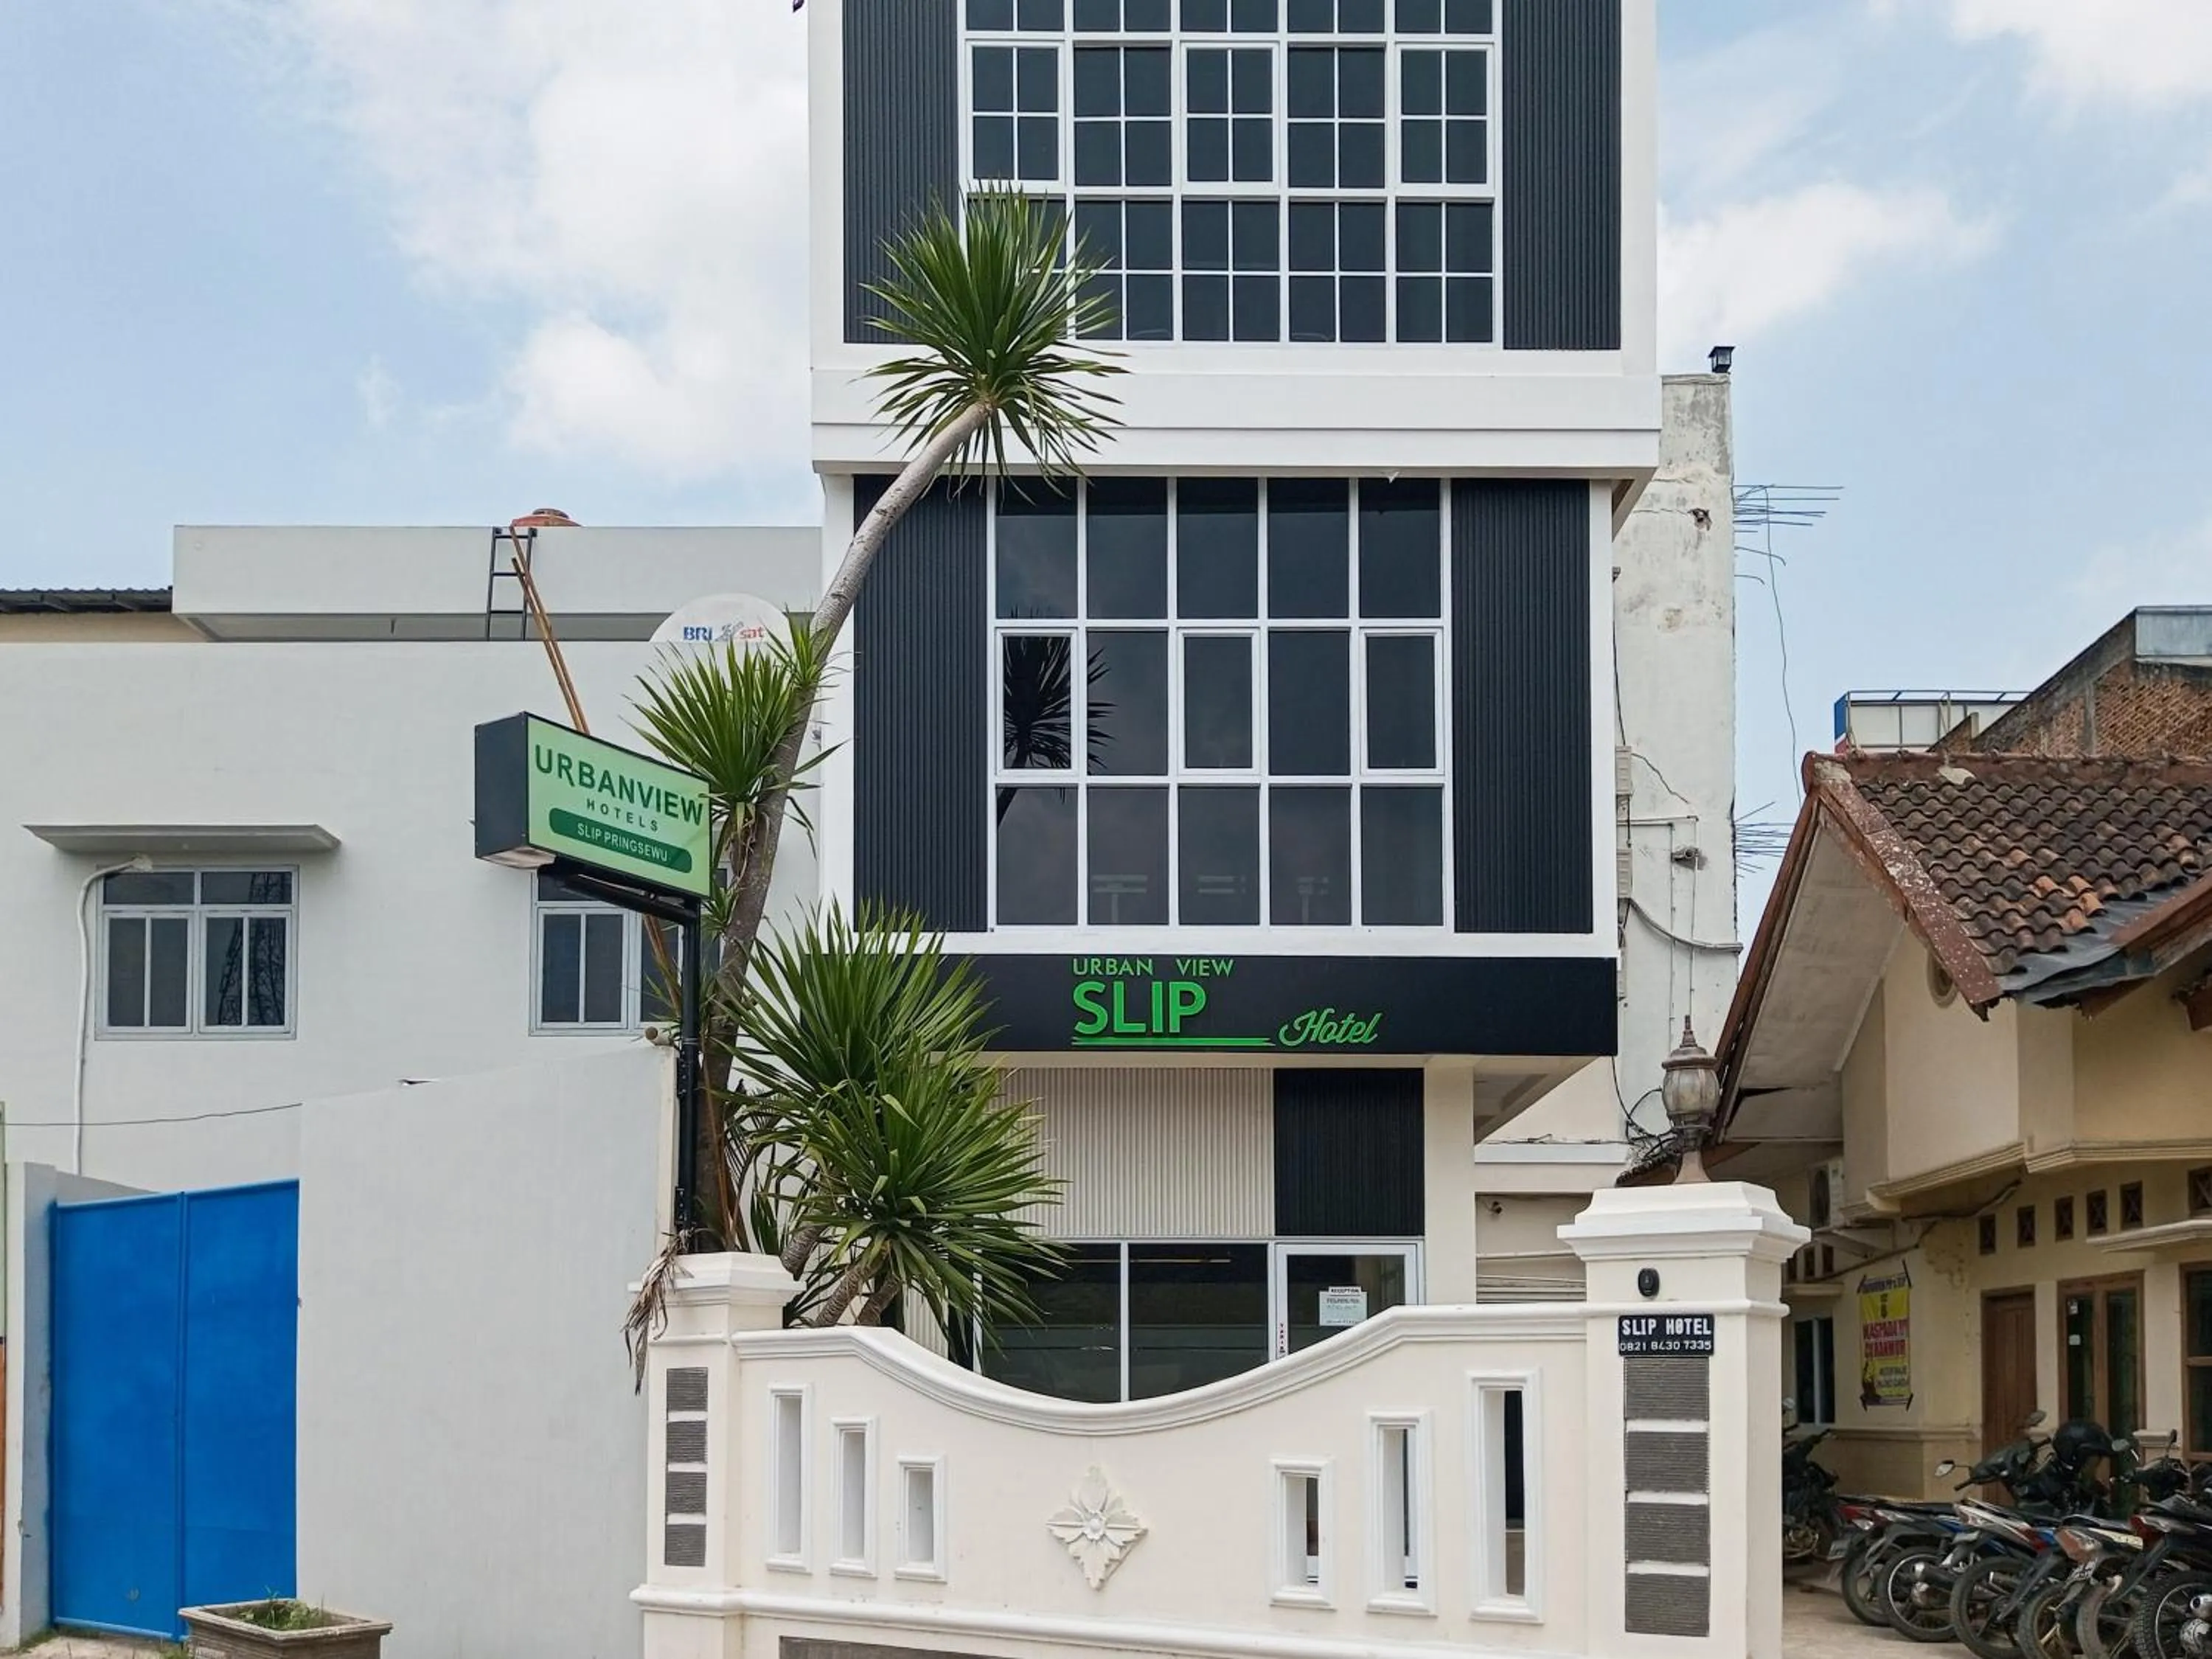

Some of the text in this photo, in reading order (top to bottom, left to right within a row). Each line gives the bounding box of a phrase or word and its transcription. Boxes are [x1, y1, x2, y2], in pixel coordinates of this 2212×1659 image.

[535, 744, 704, 827] URBANVIEW
[587, 799, 658, 832] HOTELS
[577, 823, 668, 863] SLIP PRINGSEWU
[1073, 959, 1234, 977] URBAN VIEW
[1073, 981, 1207, 1034] SLIP
[1278, 1007, 1384, 1047] Hotel
[1621, 1318, 1711, 1335] SLIP HOTEL
[1620, 1341, 1646, 1352] 0821
[1683, 1340, 1711, 1350] 7335
